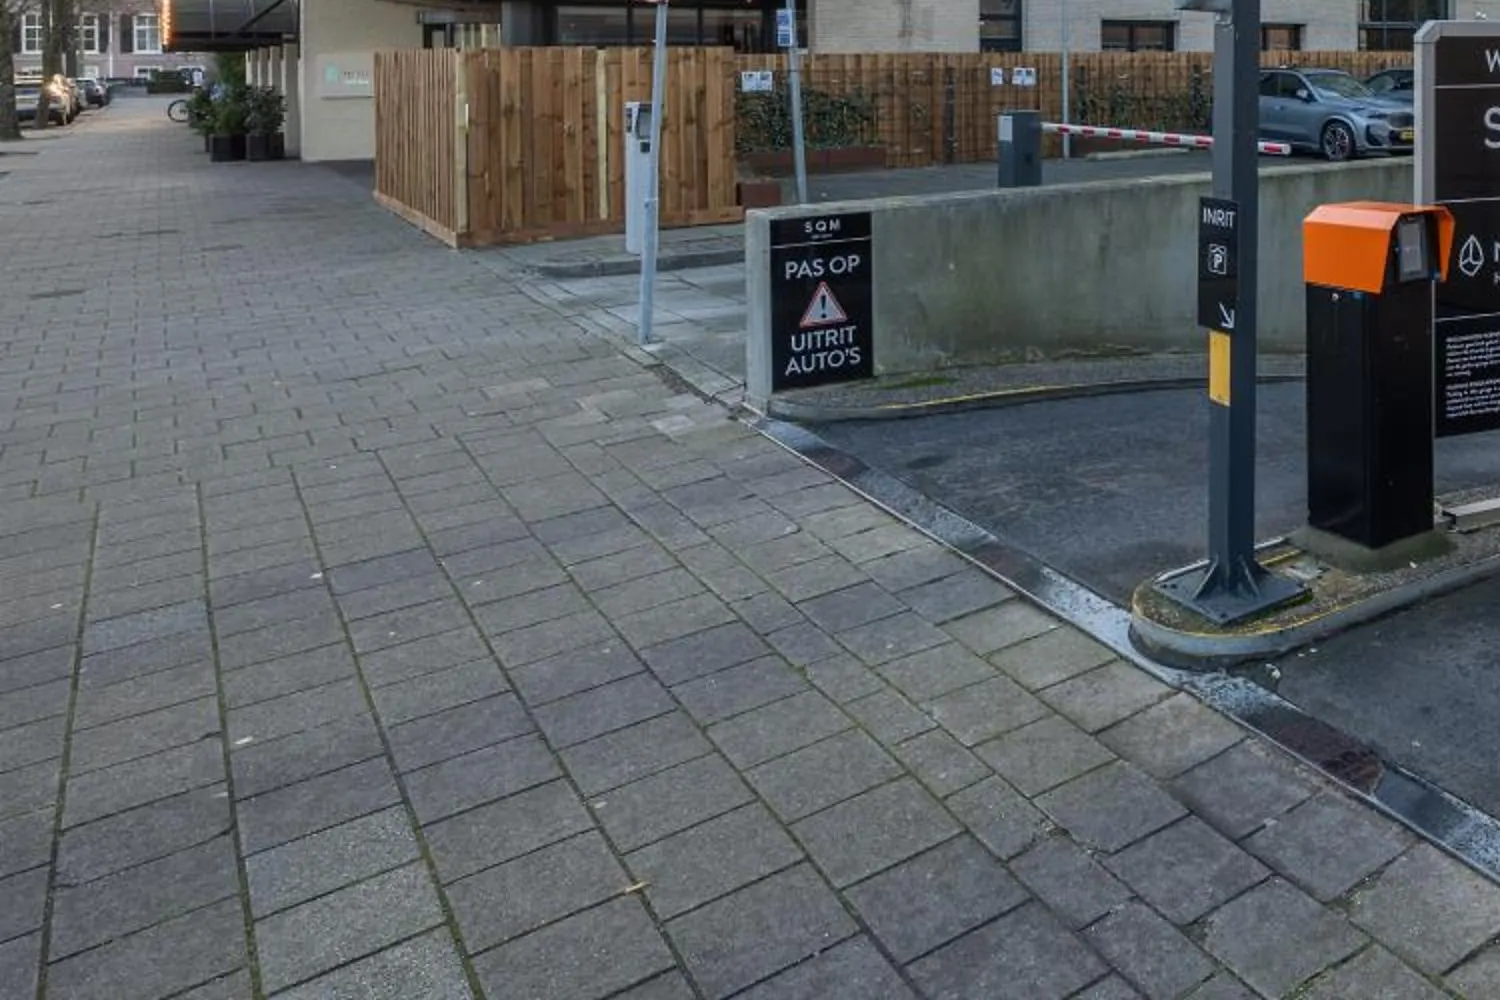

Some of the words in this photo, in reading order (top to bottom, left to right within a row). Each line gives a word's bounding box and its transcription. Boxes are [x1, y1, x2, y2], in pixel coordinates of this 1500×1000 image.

[1203, 207, 1237, 228] INRIT
[785, 258, 825, 280] PAS
[829, 255, 860, 274] OP
[791, 325, 857, 351] UITRIT
[785, 347, 861, 377] AUTO'S
